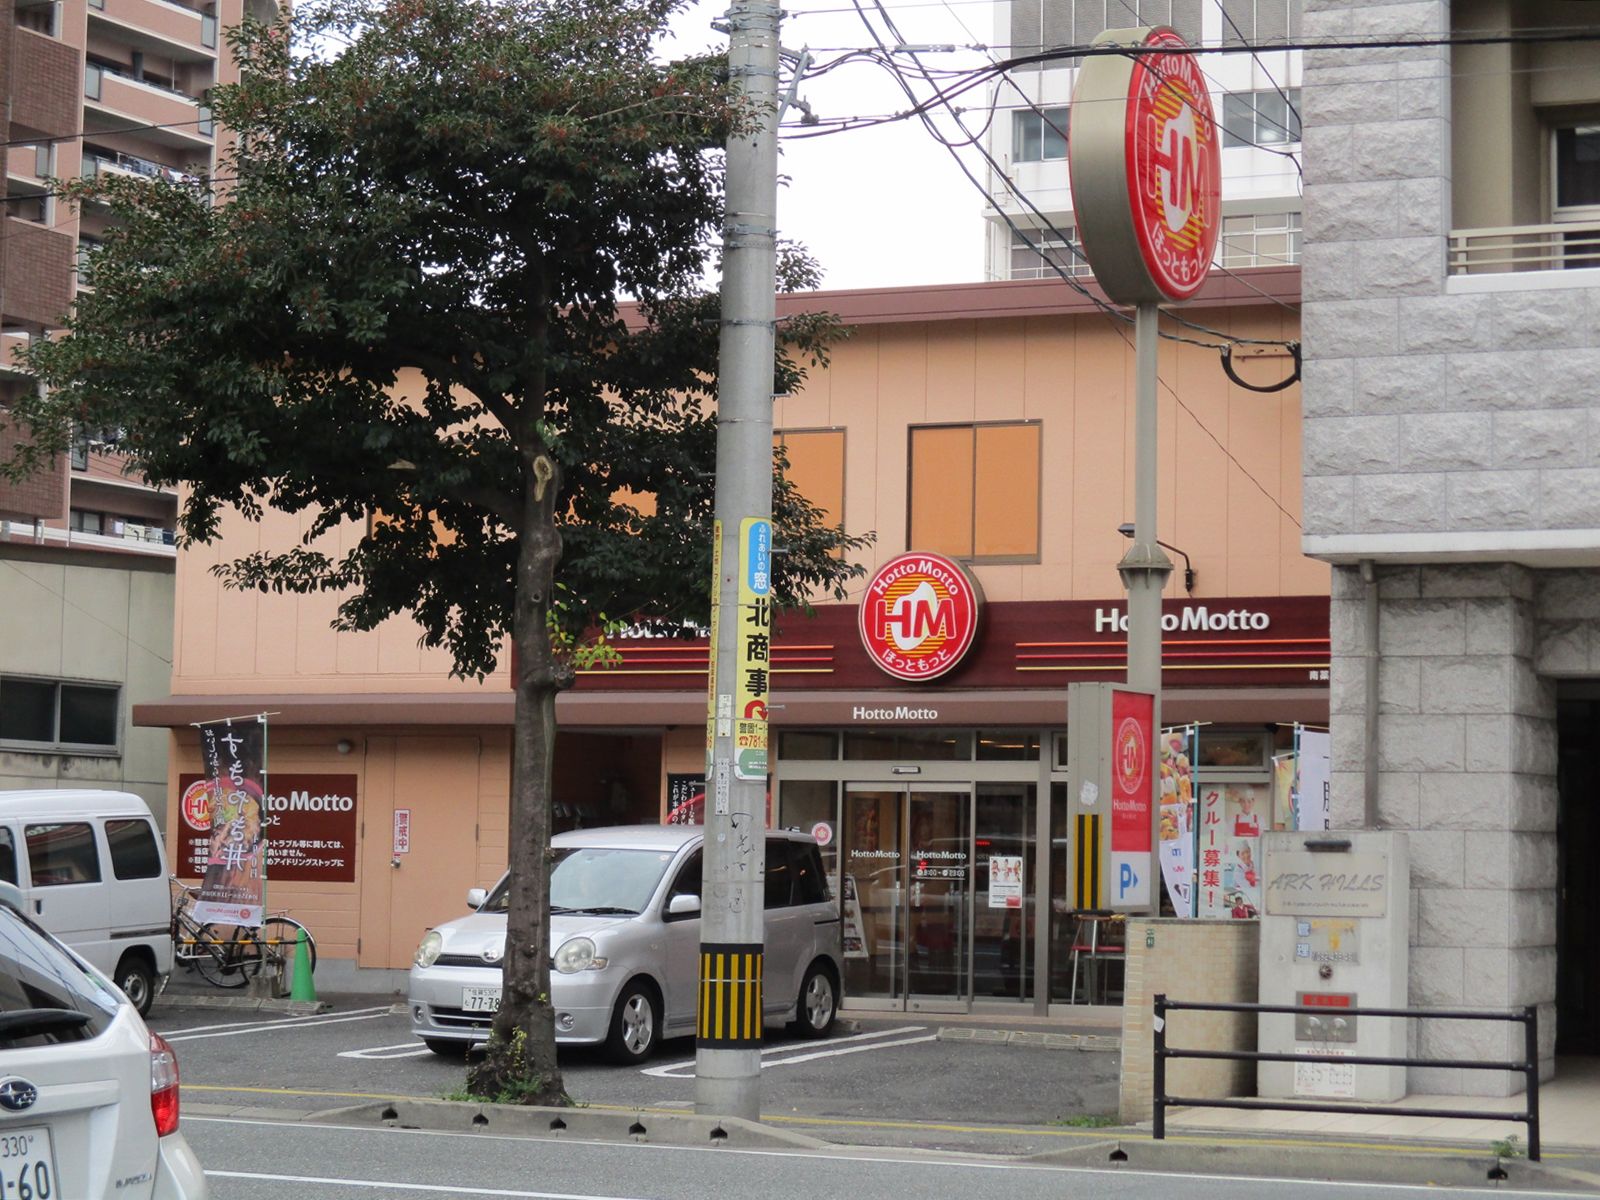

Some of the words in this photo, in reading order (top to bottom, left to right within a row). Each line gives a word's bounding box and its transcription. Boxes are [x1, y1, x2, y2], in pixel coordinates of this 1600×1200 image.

[1146, 112, 1211, 229] HM
[1153, 220, 1206, 282] ほっともっと
[873, 560, 959, 596] HottoMotto
[875, 598, 957, 640] HM
[1095, 606, 1270, 633] HooMotto
[745, 598, 769, 697] 北商事
[882, 649, 951, 672] ほっともっと
[853, 707, 938, 720] HottoMotto
[262, 791, 353, 812] toMotto
[264, 848, 306, 857] 負いません。
[264, 858, 345, 867] めアイドリングストップに
[1120, 863, 1132, 899] P
[1267, 873, 1316, 891] ARK
[1319, 873, 1385, 891] HILLS
[1, 1135, 28, 1158] 330
[0, 1160, 50, 1200] -60
